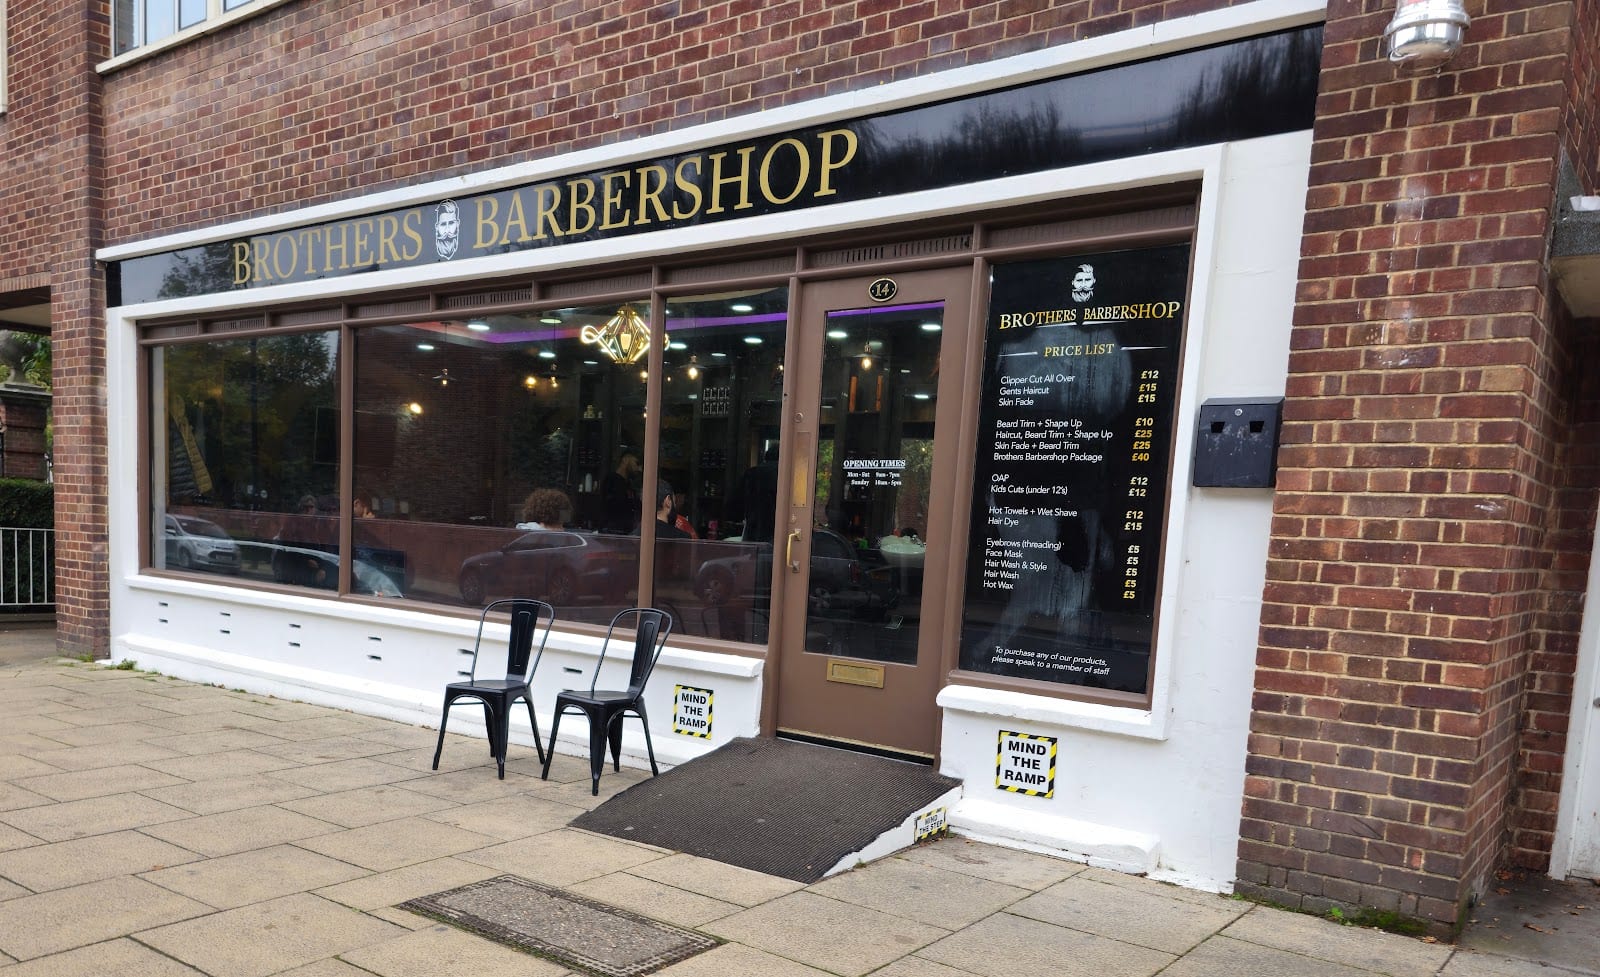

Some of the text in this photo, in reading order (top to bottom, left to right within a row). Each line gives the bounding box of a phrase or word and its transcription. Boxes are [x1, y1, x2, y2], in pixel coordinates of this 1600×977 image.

[233, 128, 858, 285] BROTHERS BARBERSHOP
[876, 283, 890, 297] 14
[1000, 301, 1180, 329] BROTHERS BARBERSHOP
[1044, 343, 1114, 357] PRICE LIST
[1141, 371, 1159, 379] £12
[1001, 374, 1075, 386] Clipper Cut All Over
[1000, 386, 1049, 395] Gents Haircut
[1139, 384, 1157, 392] £15
[999, 398, 1034, 406] Skin Fade
[1138, 394, 1156, 403] £15
[997, 419, 1018, 428] Beard
[1020, 419, 1035, 428] Trim
[1044, 419, 1068, 430] Shape
[1070, 419, 1082, 429] Up
[1136, 418, 1153, 426] £10
[996, 431, 1023, 440] Haircut,
[1025, 430, 1047, 439] Beard
[1048, 430, 1065, 439] Trim
[1074, 430, 1099, 440] Shape
[1101, 430, 1113, 440] Up
[1134, 430, 1152, 438] £25
[995, 442, 1009, 450] Skin
[1011, 442, 1029, 450] Fade
[1039, 441, 1061, 450] Beard
[1063, 441, 1079, 450] Trim
[1133, 441, 1150, 450] £25
[994, 453, 1103, 463] Brothers Barbershop Package
[1132, 453, 1150, 461] £40
[991, 474, 1009, 482] OAP
[1130, 477, 1148, 485] £12
[991, 485, 1068, 495] Kids Cuts (under 12's)
[1128, 489, 1146, 497] £12
[989, 507, 1003, 515] Hot
[1004, 507, 1028, 515] Towels
[1037, 508, 1053, 516] Wet
[1054, 508, 1077, 517] Shave
[1126, 511, 1143, 519] £12
[988, 517, 1019, 527] Hair Dye
[1124, 522, 1142, 531] £15
[986, 539, 1061, 551] Eyebrows (threading)
[1128, 545, 1140, 554] £5
[985, 549, 1023, 558] Face Mask
[985, 560, 1000, 568] Hair
[1000, 560, 1020, 568] Wash
[1029, 562, 1048, 571] Style
[1127, 557, 1139, 565] £5
[984, 570, 1019, 579] Hair Wash
[1126, 568, 1137, 576] £5
[983, 580, 1014, 590] Hot Wax
[1124, 580, 1137, 588] £5
[1123, 591, 1135, 599] £5
[1004, 647, 1035, 658] purchase
[1036, 652, 1049, 661] any
[1050, 652, 1058, 660] of
[1073, 655, 1107, 667] products,
[992, 655, 1014, 665] please
[1015, 658, 1035, 668] speak
[1052, 662, 1082, 672] member
[1084, 665, 1092, 673] of
[1093, 666, 1111, 675] staff
[681, 692, 707, 705] MIND
[683, 705, 704, 716] THE
[678, 717, 707, 729] RAMP
[1007, 740, 1047, 756] MIND
[1011, 755, 1041, 770] THE
[1004, 770, 1047, 786] RAMP
[920, 825, 929, 834] THE
